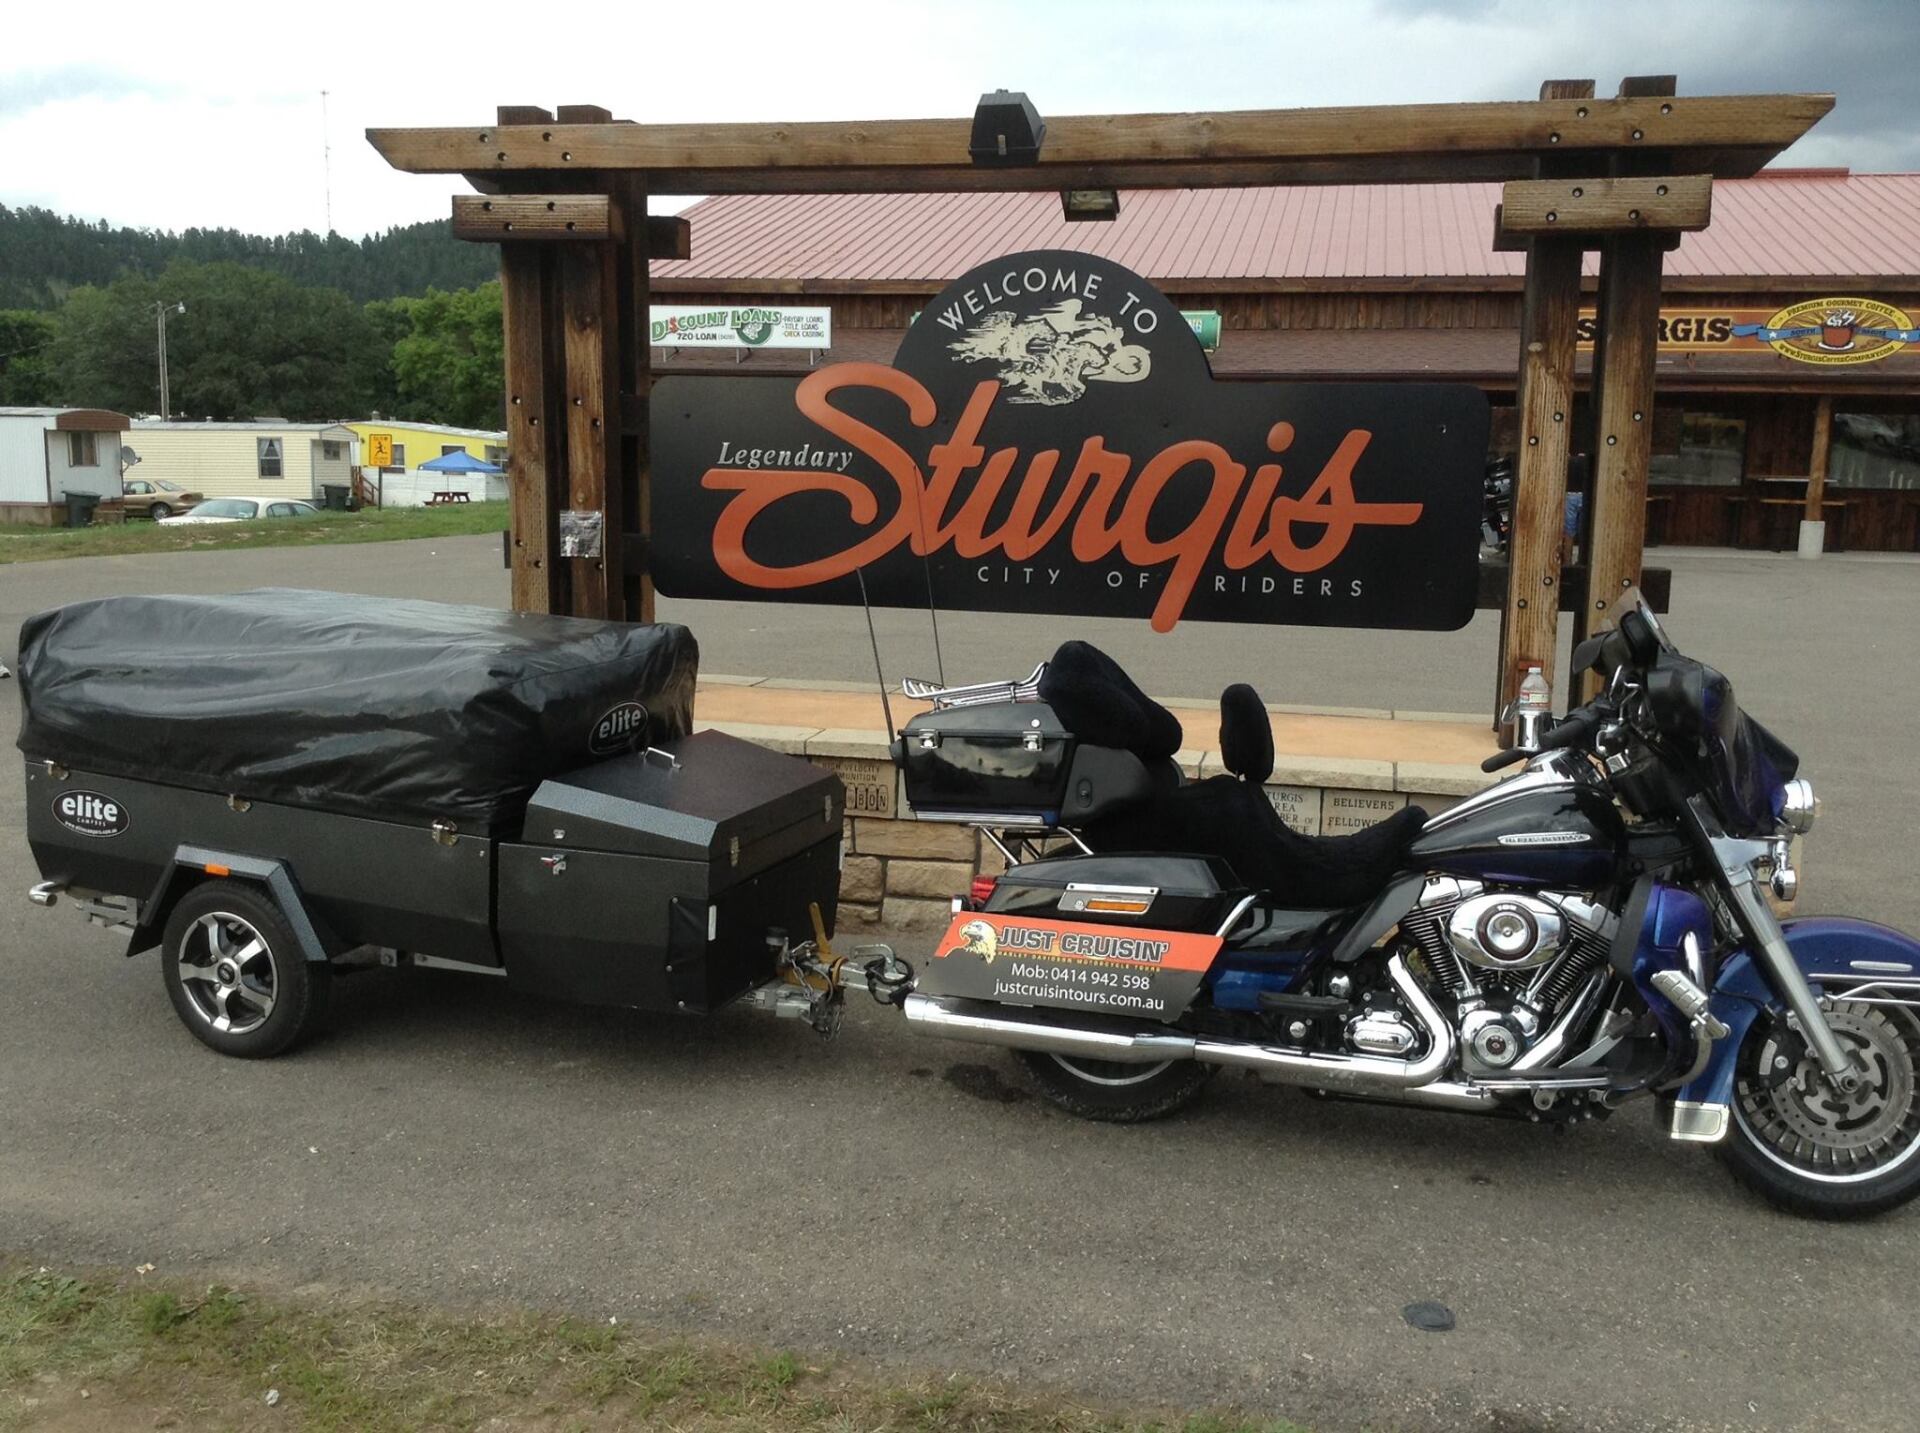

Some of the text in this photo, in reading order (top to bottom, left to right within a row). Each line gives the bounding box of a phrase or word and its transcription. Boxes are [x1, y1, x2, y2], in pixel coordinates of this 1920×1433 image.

[937, 267, 1158, 334] WELCOME TO
[1786, 300, 1895, 317] PREMIUM GOURMET COFFEE
[731, 309, 782, 329] LOANS
[1577, 318, 1731, 343] SRGIS
[717, 442, 853, 472] Legendary
[701, 362, 1423, 633] Sturgis
[976, 565, 1363, 597] CITY OF RIDERS
[598, 708, 642, 739] elite
[62, 794, 118, 822] elite
[1274, 802, 1296, 813] REA
[1333, 797, 1395, 811] BELIEVERS
[998, 926, 1169, 963] JUST CRUISIN'
[998, 951, 1028, 959] HARLEY
[1032, 954, 1072, 964] DAVIDSON
[1076, 958, 1130, 970] MOTORCYCLE
[1011, 962, 1151, 991] Mob: 0414 942 598
[993, 978, 1165, 1011] justcruisintours.com.au
